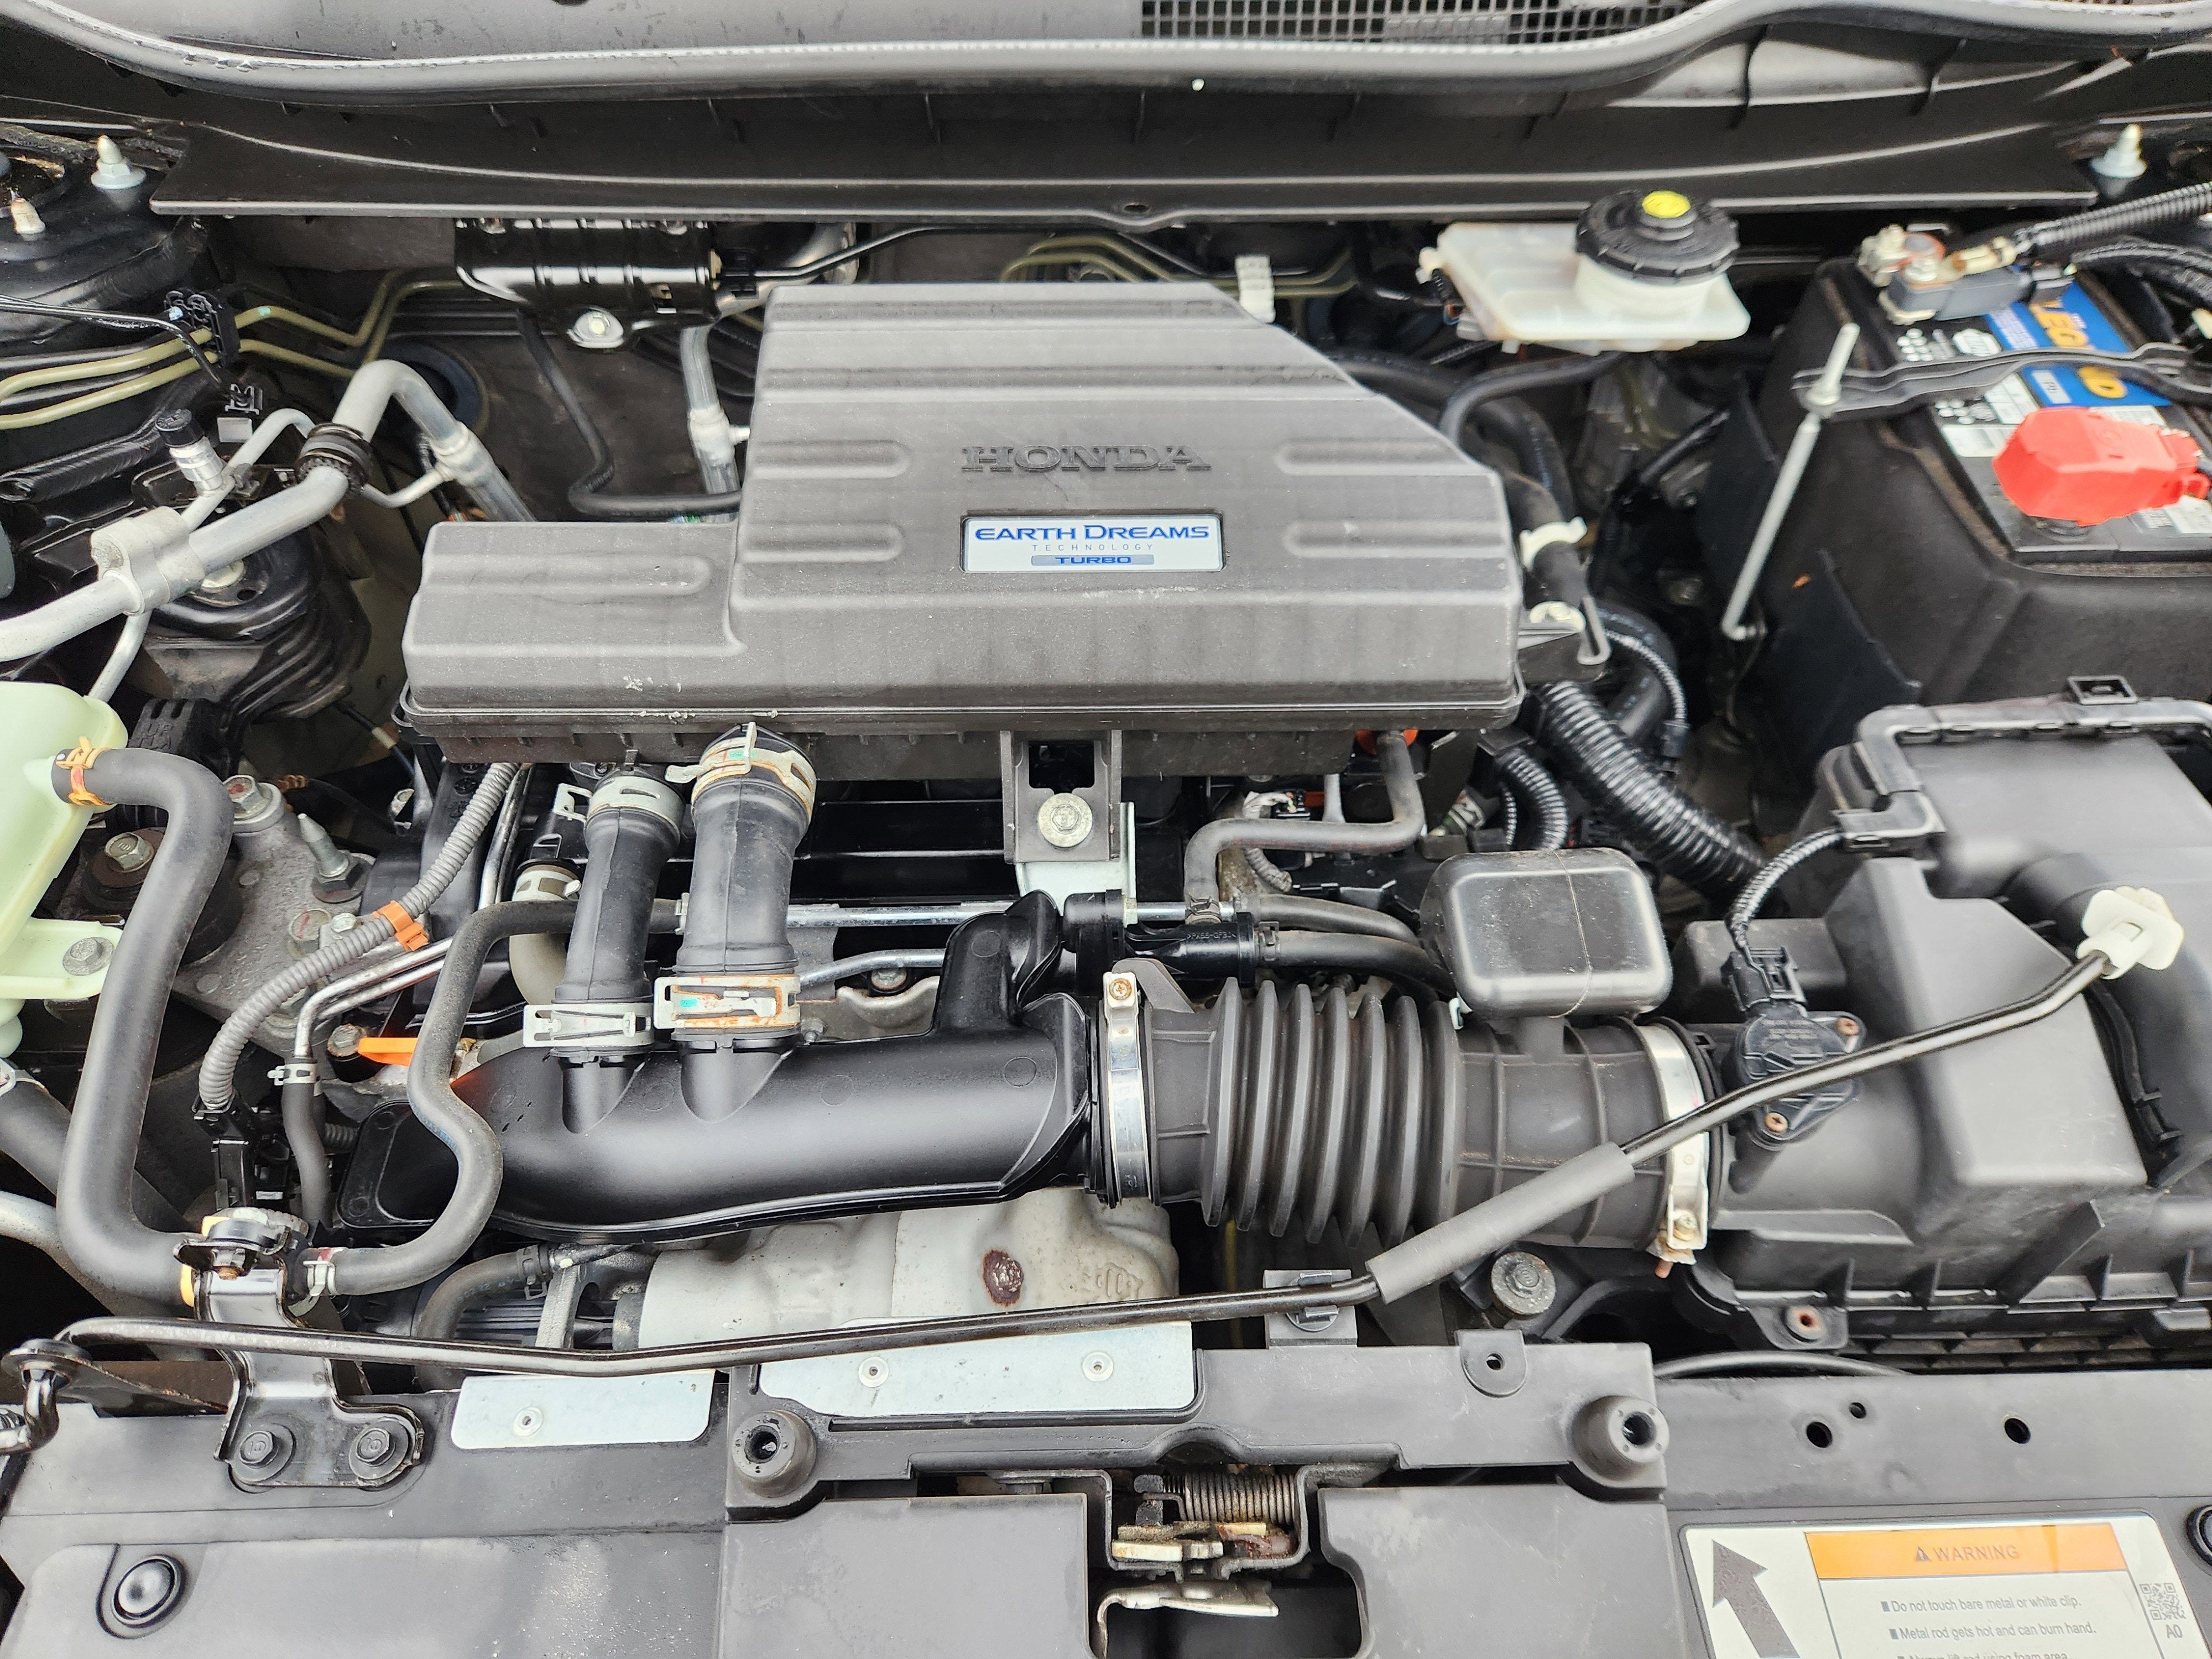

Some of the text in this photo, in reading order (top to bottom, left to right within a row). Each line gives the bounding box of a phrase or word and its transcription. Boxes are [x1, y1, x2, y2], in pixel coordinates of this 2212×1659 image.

[961, 445, 1212, 472] HONDA
[975, 525, 1210, 541] EARTH DREAMS
[1055, 556, 1131, 565] TURBO
[1933, 1545, 2019, 1562] WARNING
[1891, 1595, 2082, 1612] Do not touch bare metal or white clip.
[1898, 1621, 2097, 1641] Metal rod gets hot and can burn hand.
